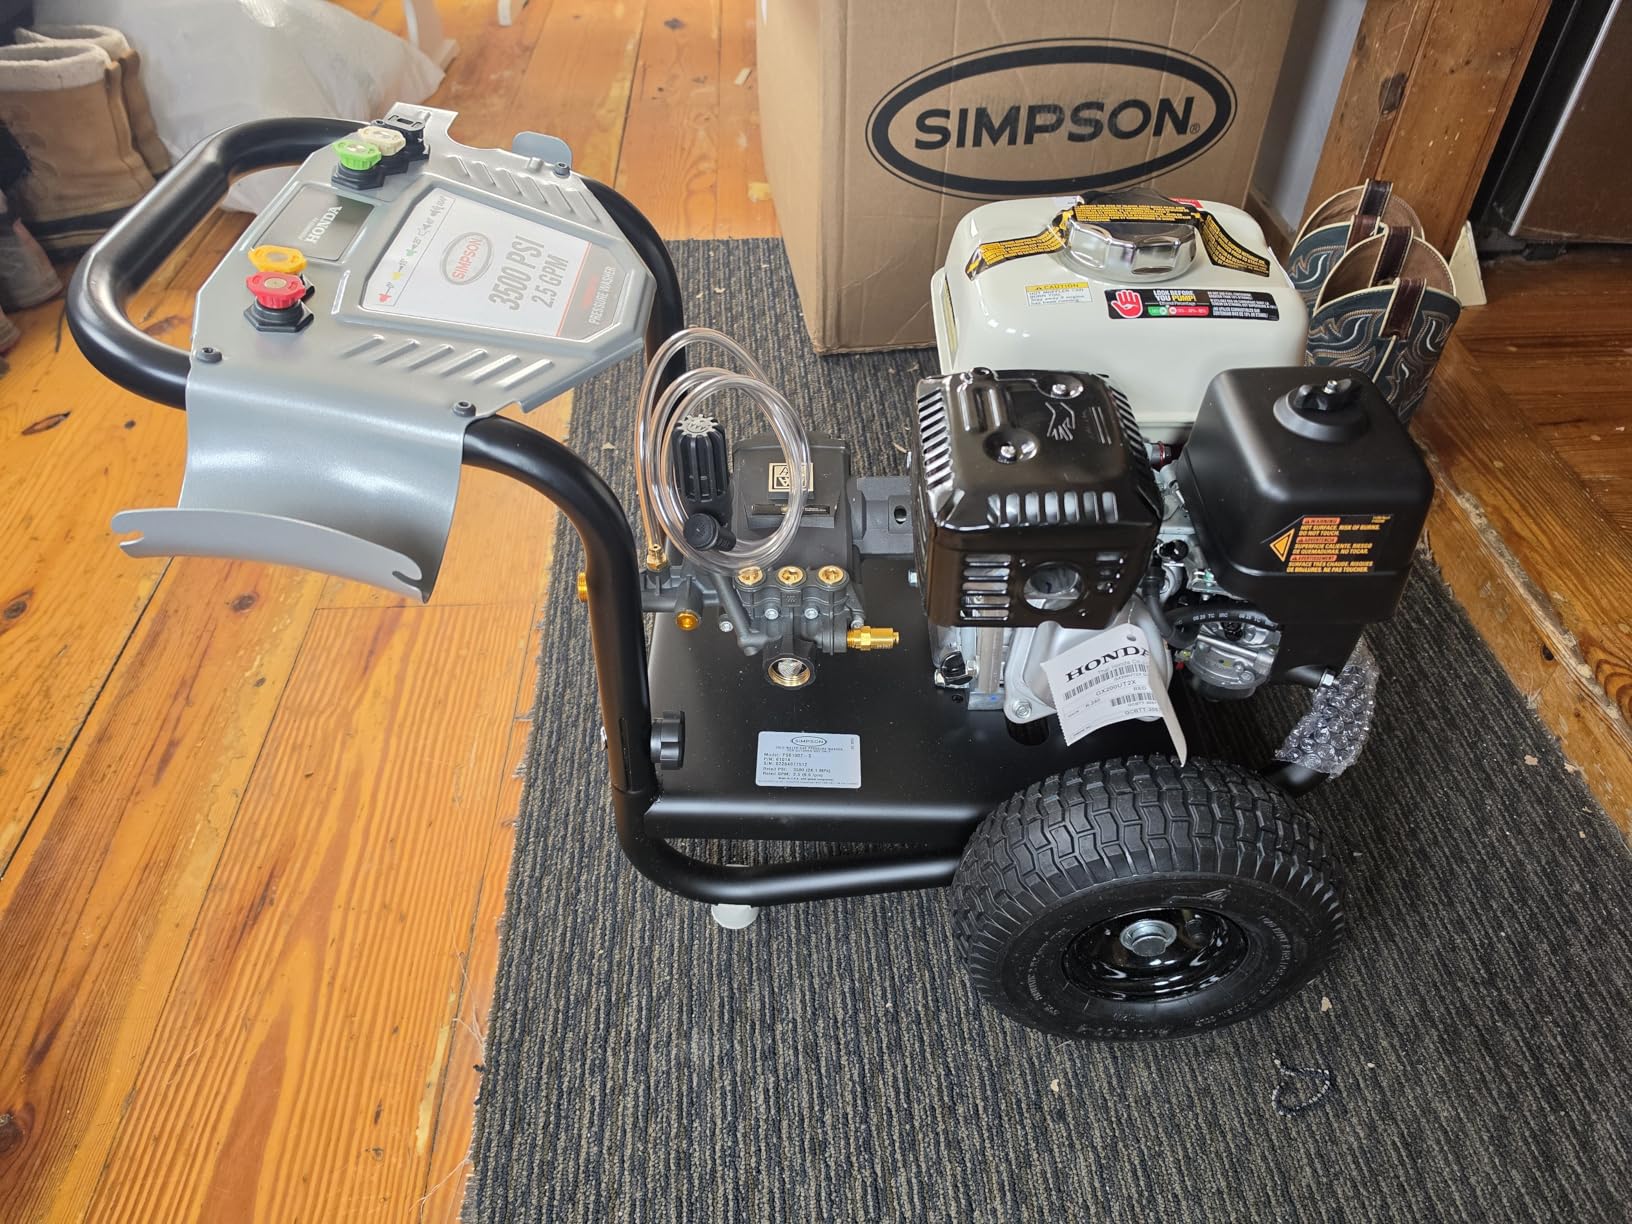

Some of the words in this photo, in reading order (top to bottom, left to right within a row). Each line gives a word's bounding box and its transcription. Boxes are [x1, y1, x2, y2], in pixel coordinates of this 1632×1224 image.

[914, 96, 1195, 150] SIMPSON
[304, 206, 342, 244] HONDA
[452, 238, 482, 280] SIMPSON
[506, 235, 544, 270] PSI
[538, 254, 568, 287] GPM
[488, 266, 532, 311] 3500
[531, 284, 558, 308] 2.5
[588, 292, 609, 325] PRESSURE
[600, 266, 616, 293] WASHER
